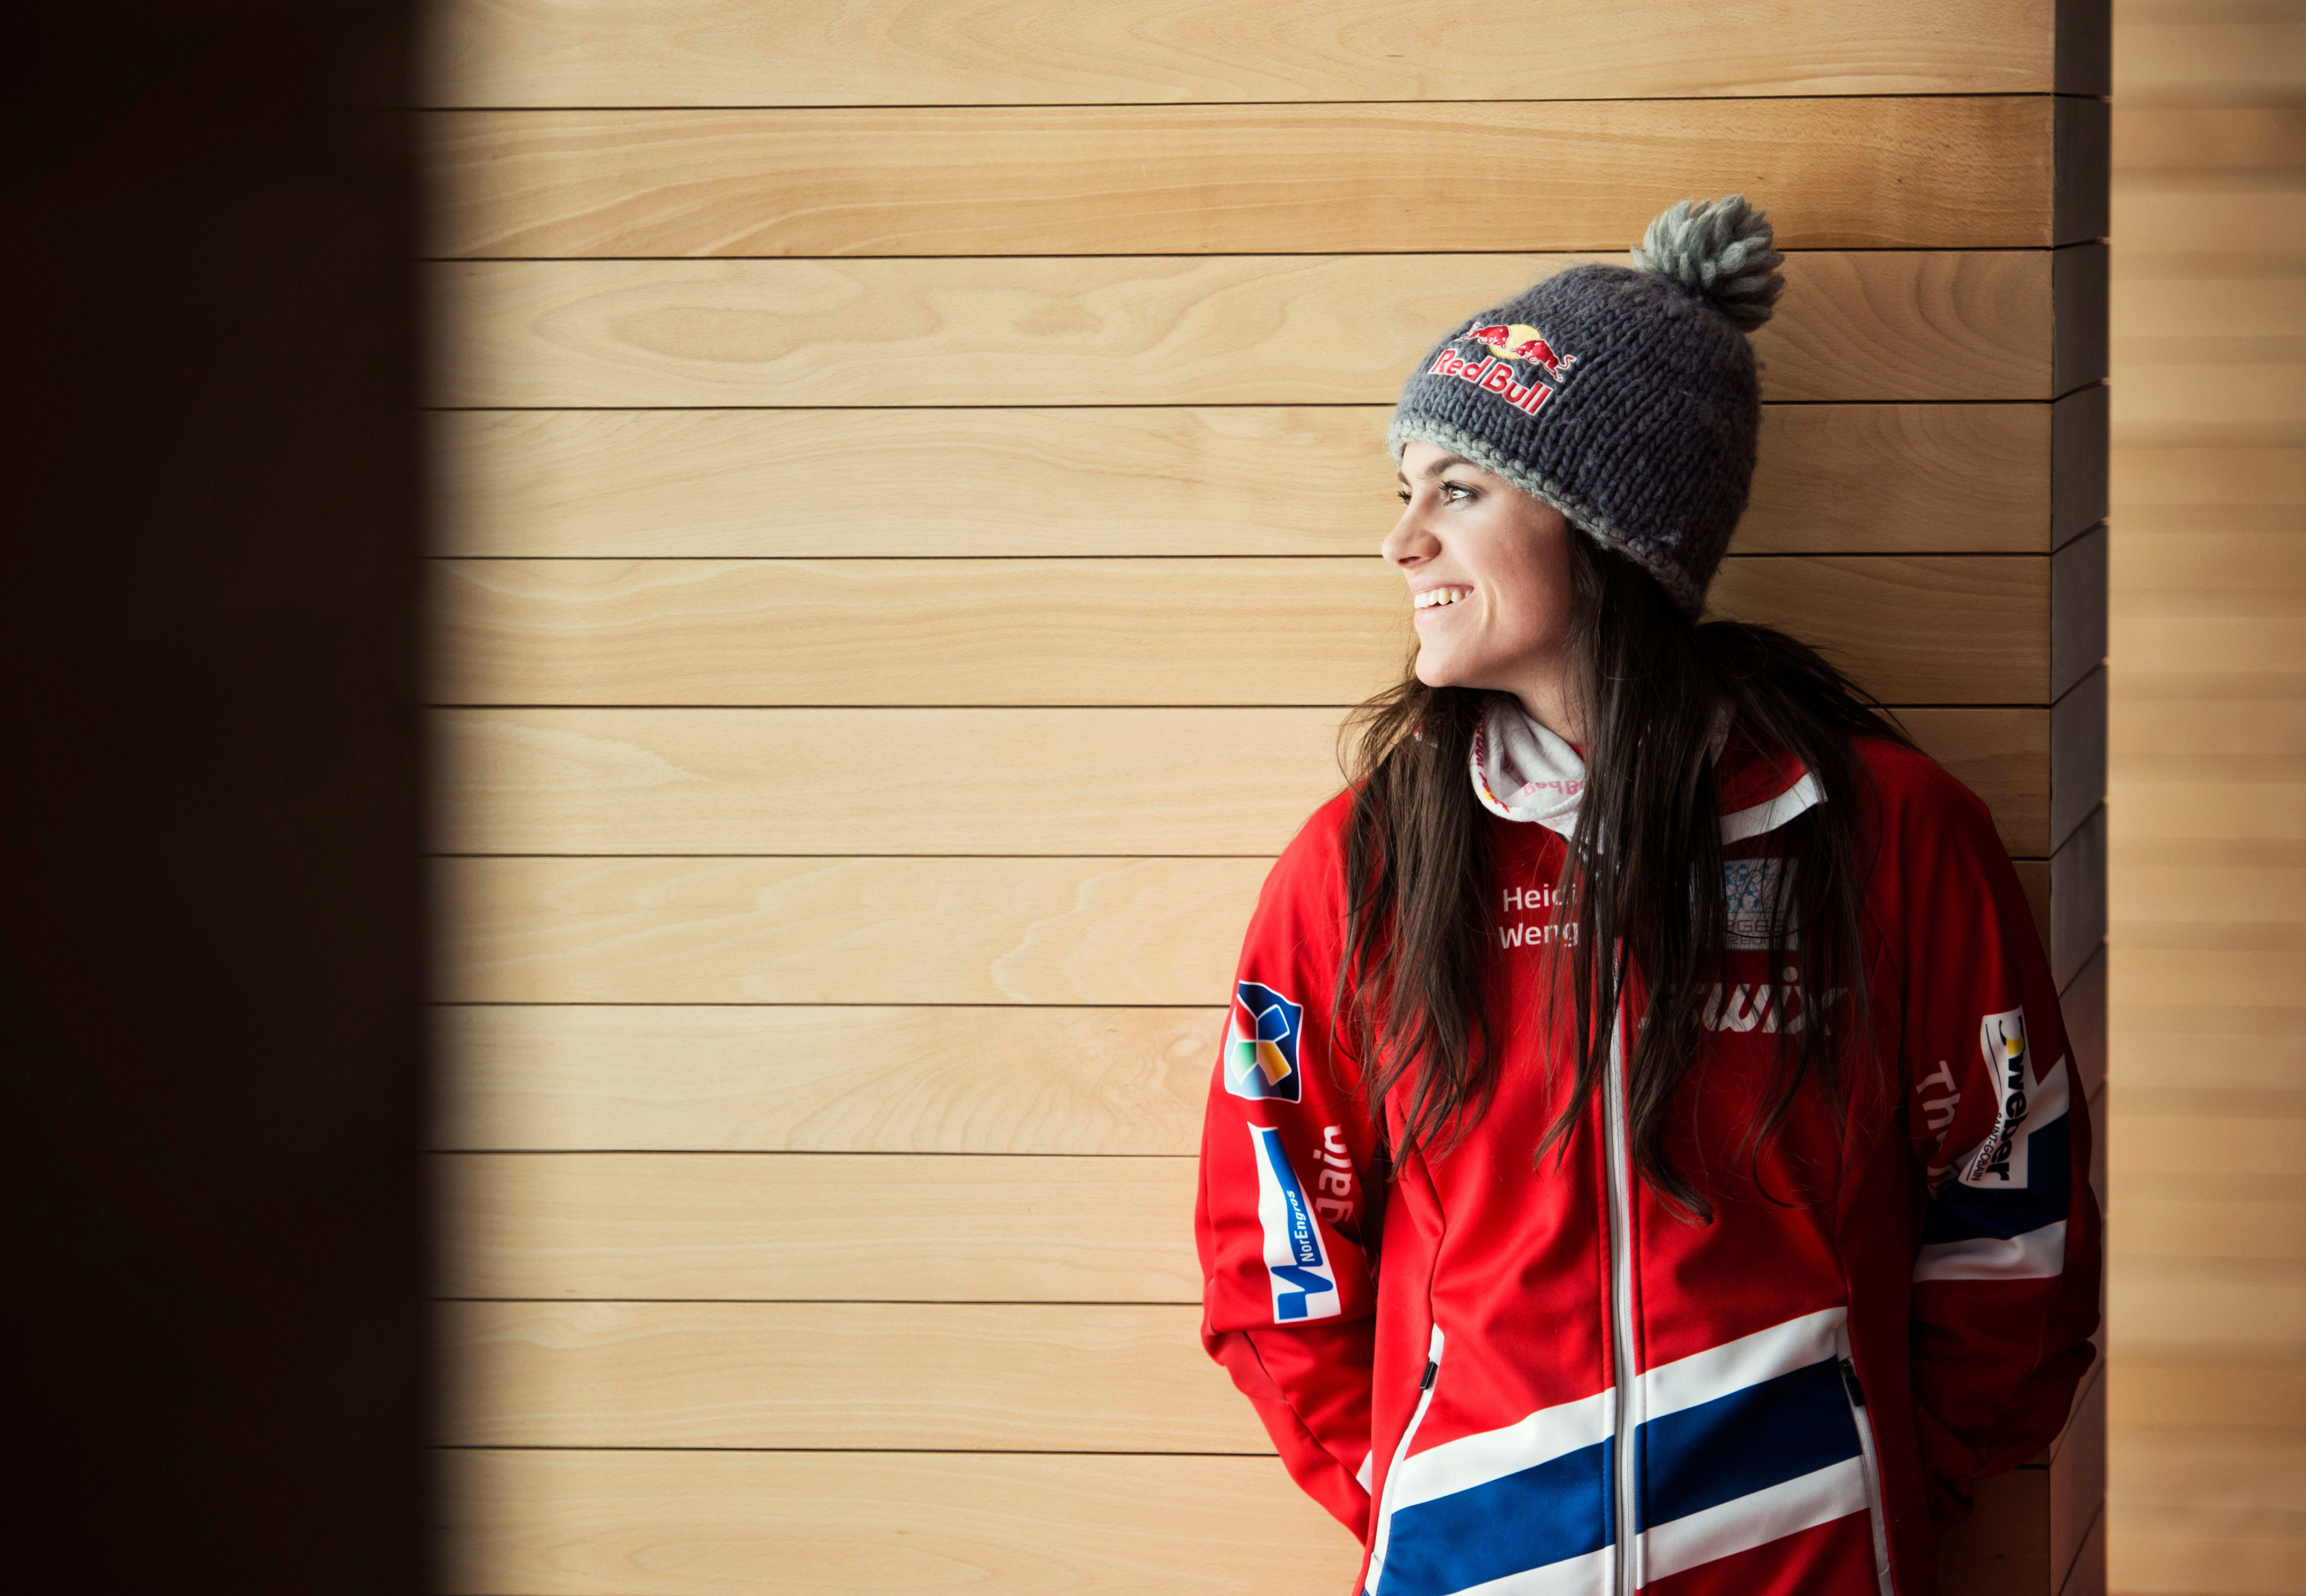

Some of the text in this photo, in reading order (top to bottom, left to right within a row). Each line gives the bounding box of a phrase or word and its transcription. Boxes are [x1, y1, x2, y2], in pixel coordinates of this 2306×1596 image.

[1427, 348, 1553, 416] Red Bull
[1499, 922, 1579, 949] Weng
[1638, 966, 1849, 1036] wix
[1986, 1049, 2029, 1181] weber
[1286, 1190, 1315, 1262] NorEngros
